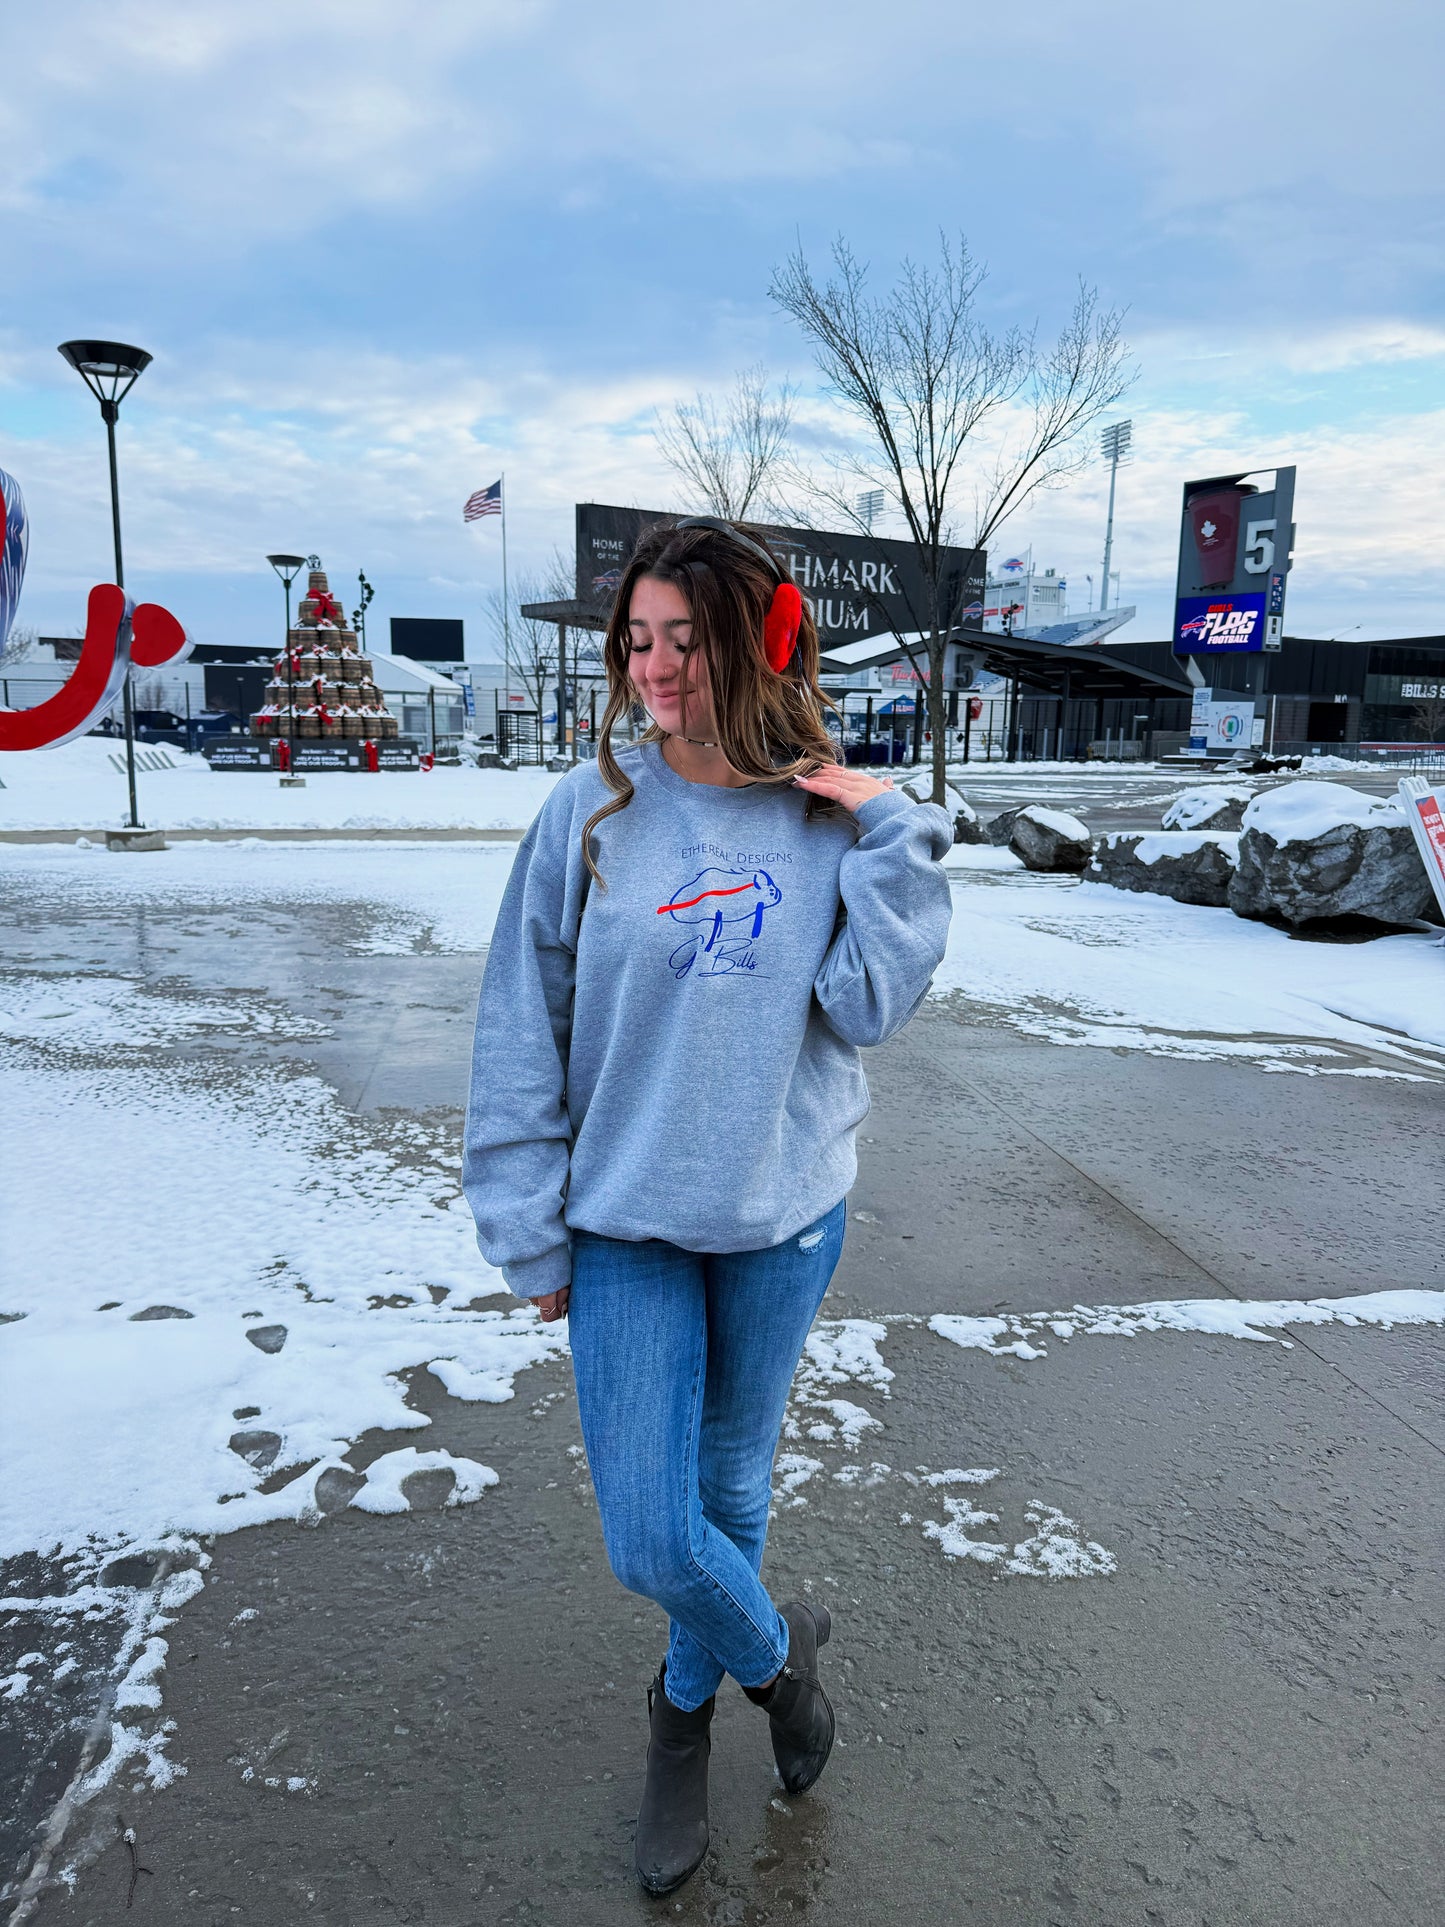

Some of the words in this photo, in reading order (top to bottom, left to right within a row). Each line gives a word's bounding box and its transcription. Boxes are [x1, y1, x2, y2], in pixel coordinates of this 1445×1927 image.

[592, 538, 624, 551] HOME
[1244, 519, 1277, 574] 5
[966, 576, 985, 588] OME
[1207, 603, 1233, 613] GIRLS
[1198, 611, 1258, 641] FLAG
[1207, 634, 1249, 645] FOOTBALL
[957, 653, 975, 688] 5
[1405, 683, 1438, 698] BILLS
[681, 842, 731, 862] ETHEREAL
[737, 852, 793, 864] DESIGNS
[702, 937, 763, 977] Bills
